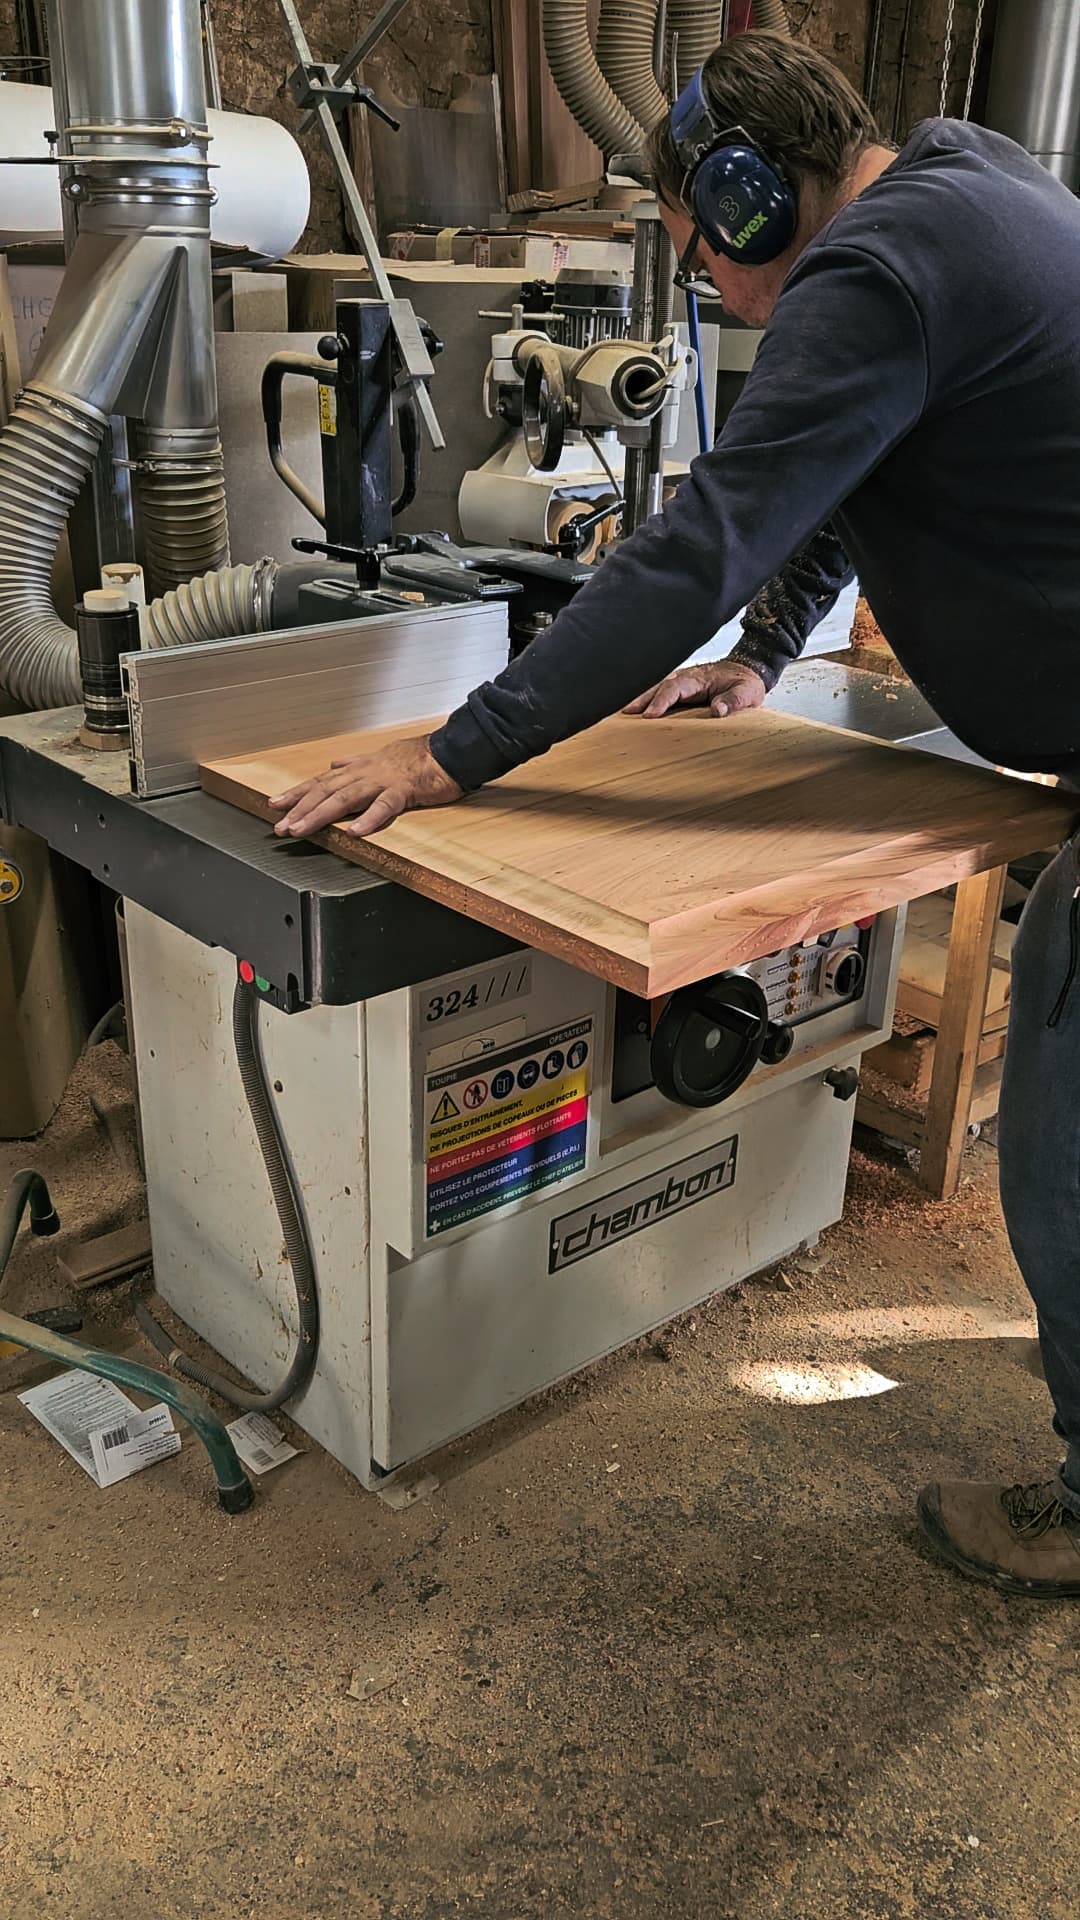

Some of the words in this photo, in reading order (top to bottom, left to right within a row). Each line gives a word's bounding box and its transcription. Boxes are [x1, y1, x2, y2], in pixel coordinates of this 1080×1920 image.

[719, 195, 740, 221] 3
[732, 210, 769, 249] uvex
[549, 1023, 590, 1045] OPERATEUR
[431, 1072, 458, 1088] TOUPIE
[430, 1143, 441, 1153] DE
[442, 1126, 492, 1149] PROJECTIONS
[492, 1120, 503, 1130] DE
[503, 1107, 535, 1126] COPEAUX
[535, 1102, 546, 1113] OU
[546, 1098, 555, 1108] DE
[430, 1122, 463, 1140] RISQUES
[430, 1166, 441, 1174] NE
[441, 1153, 471, 1170] PORTEZ
[471, 1145, 486, 1158] PAS
[486, 1143, 497, 1153] DE
[536, 1111, 572, 1132] FLOTTANTS
[430, 1180, 462, 1199] UTILISEZ
[462, 1176, 473, 1186] LE
[472, 1157, 518, 1181] PROTECTEUR
[430, 1195, 459, 1213] PORTEZ
[459, 1189, 475, 1201] VOS
[523, 1150, 562, 1174] INDIVIDUELS
[442, 1217, 453, 1226] EN
[453, 1210, 466, 1222] CAS
[533, 1178, 541, 1187] LE
[541, 1170, 557, 1183] CHEF
[561, 1160, 727, 1258] chambon
